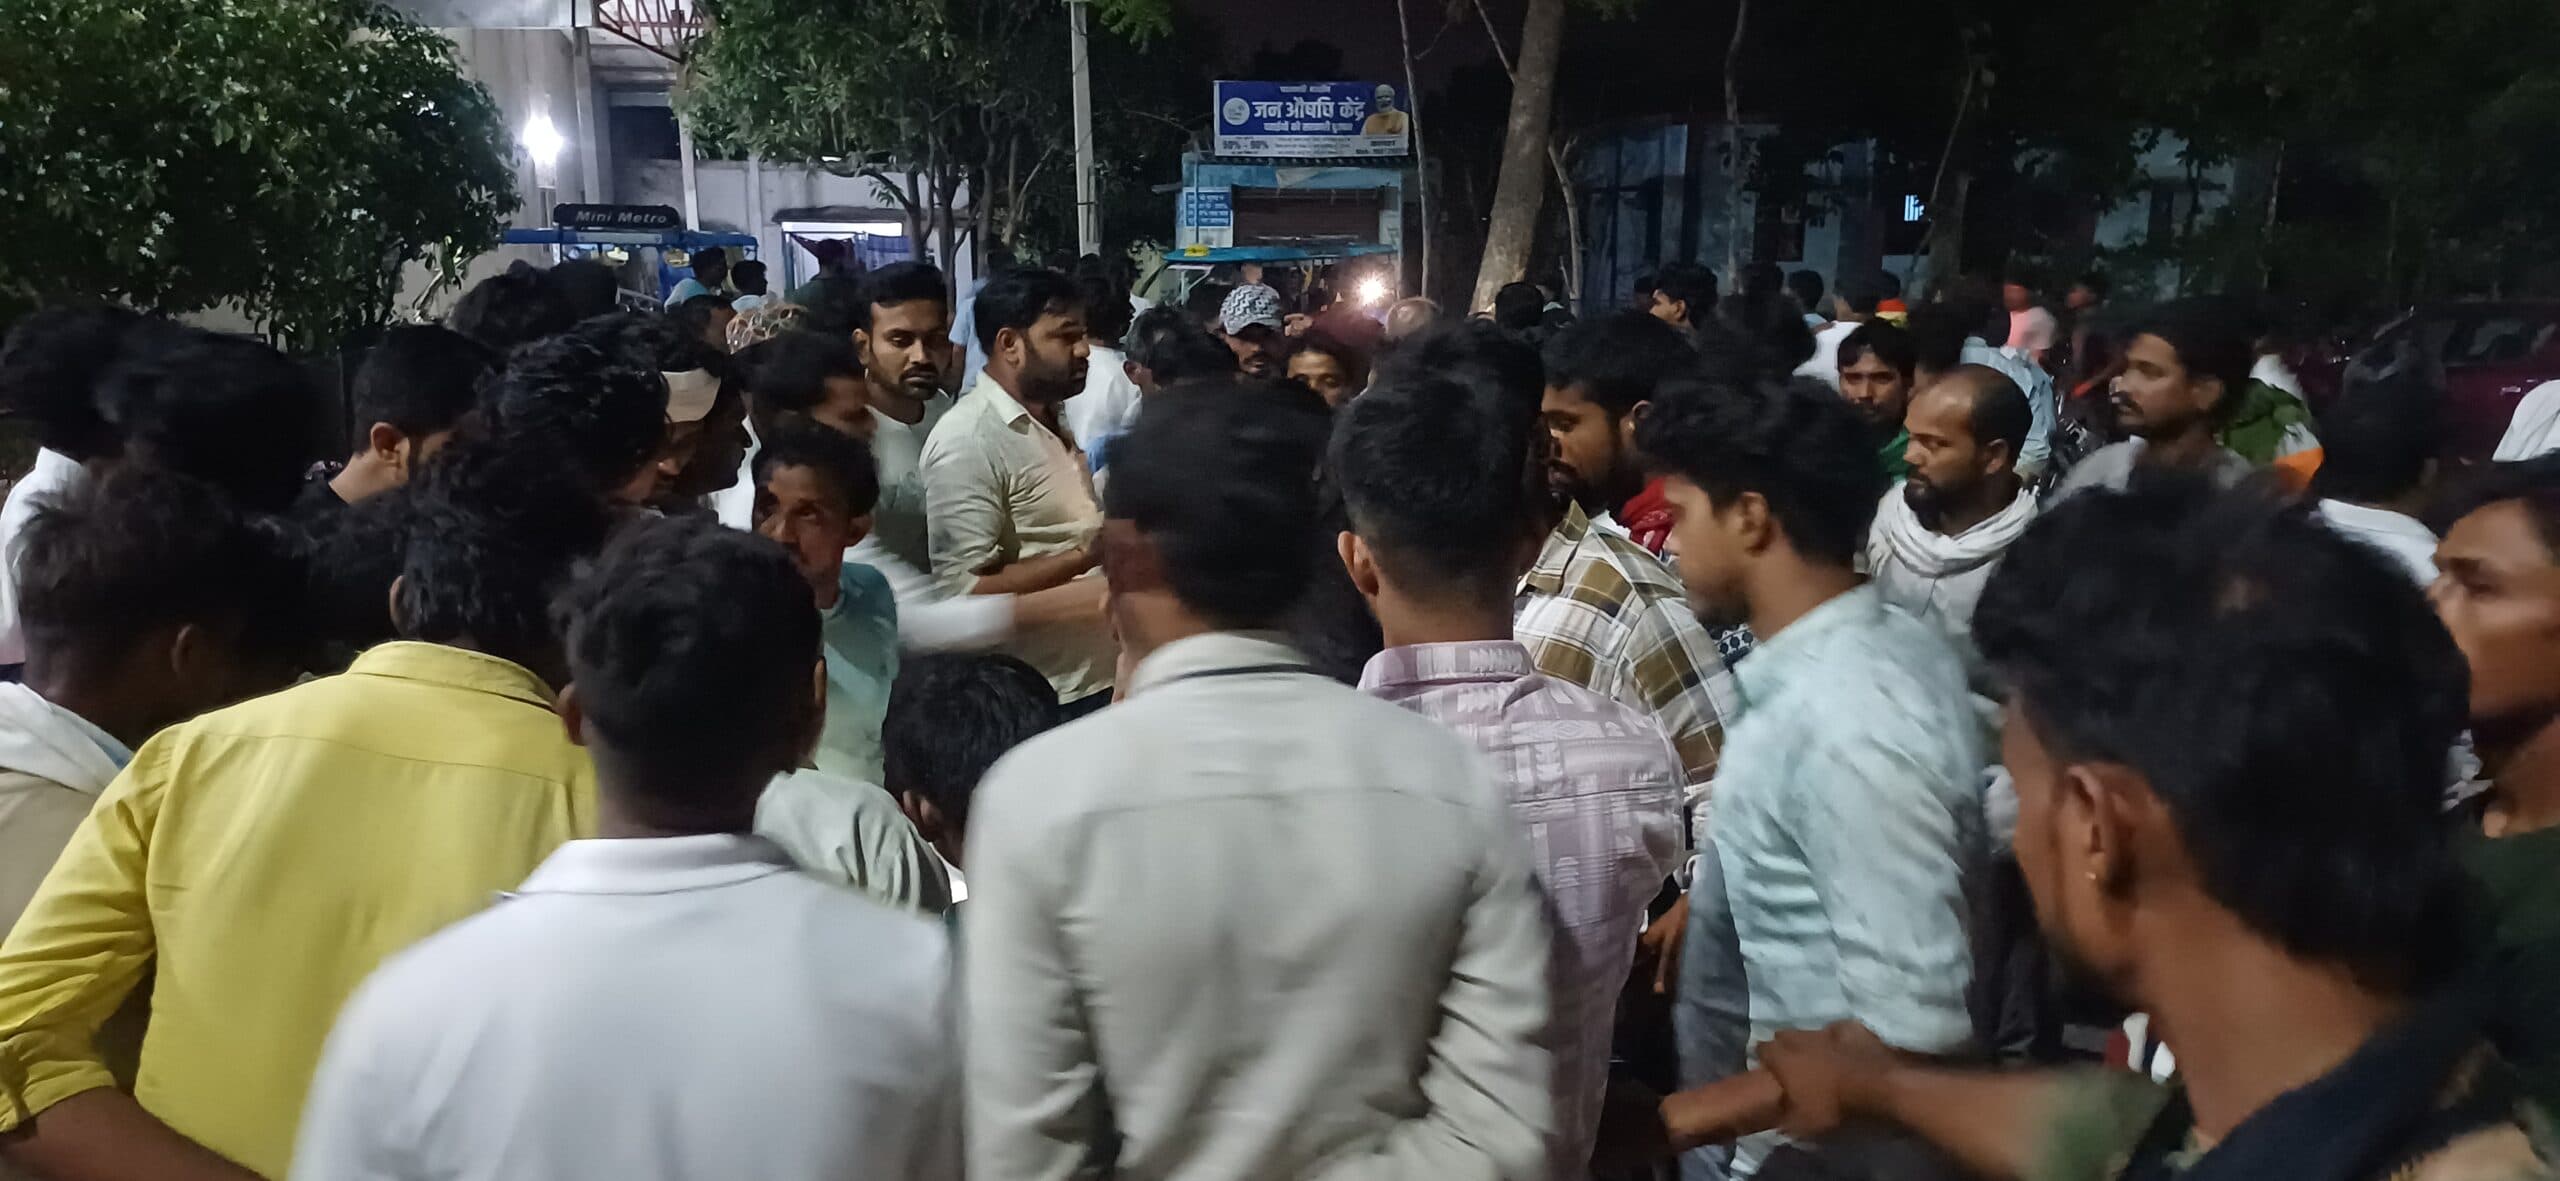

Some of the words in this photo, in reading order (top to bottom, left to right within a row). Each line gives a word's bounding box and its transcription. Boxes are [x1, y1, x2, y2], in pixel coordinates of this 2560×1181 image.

[1252, 101, 1283, 118] जन
[1285, 96, 1335, 118] औषधि
[576, 211, 612, 221] Mini
[617, 211, 668, 223] Metro
